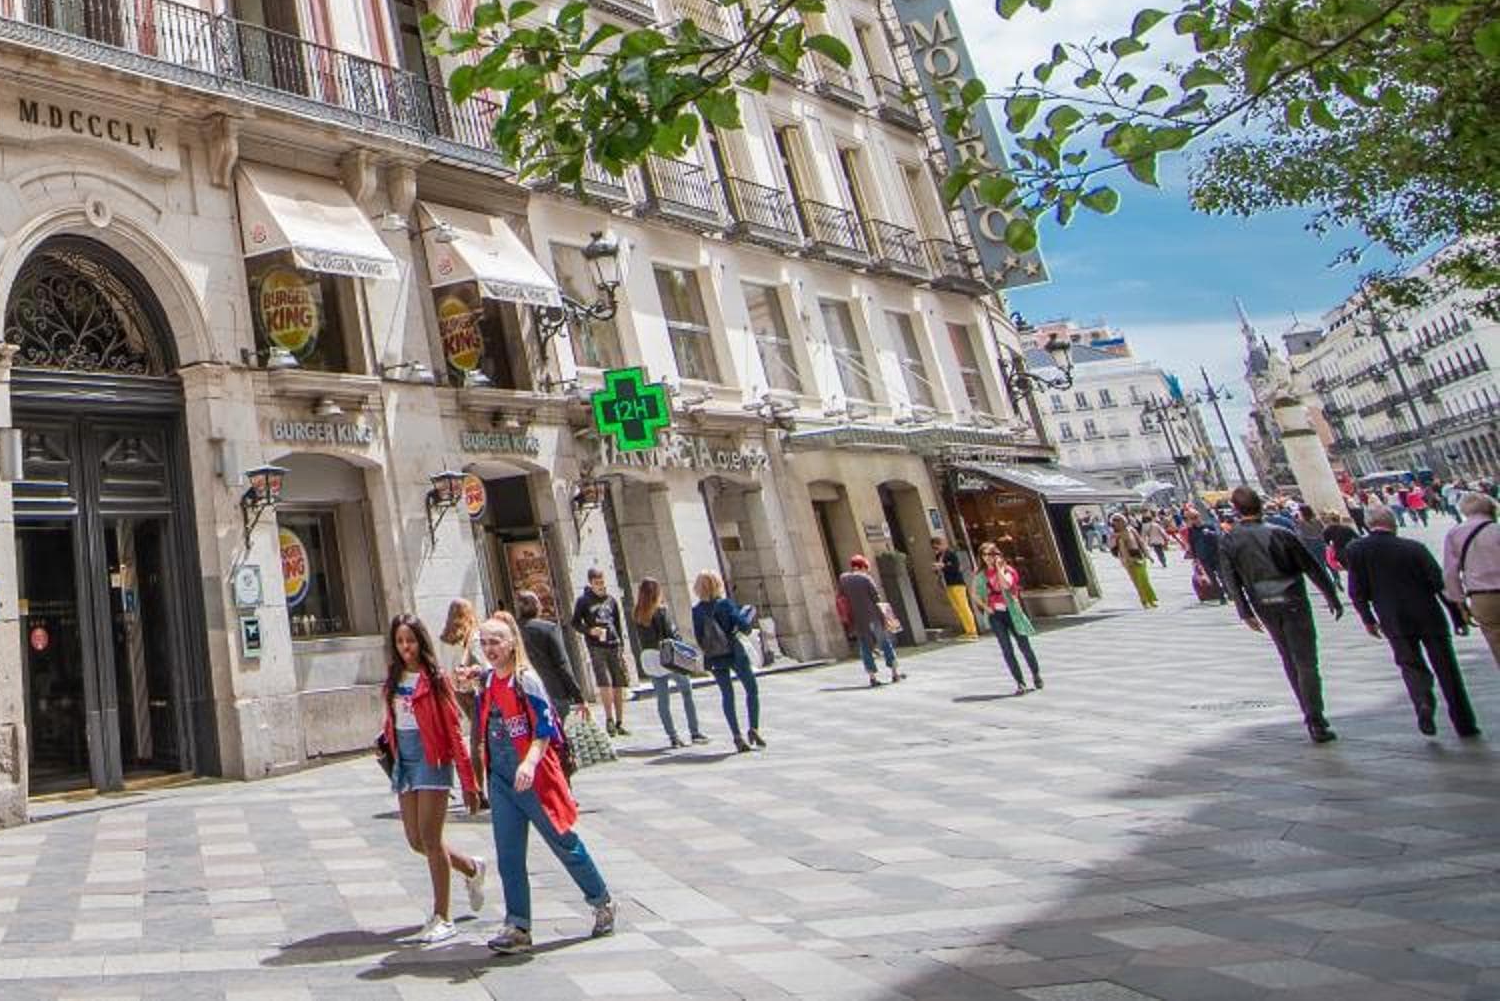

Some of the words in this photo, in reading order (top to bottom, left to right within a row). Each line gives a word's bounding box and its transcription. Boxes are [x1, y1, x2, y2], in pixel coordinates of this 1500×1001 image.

[263, 287, 311, 310] BURGER
[265, 307, 313, 331] KING
[613, 397, 647, 420] 12H
[272, 422, 335, 443] BURGER
[336, 423, 373, 444] KING
